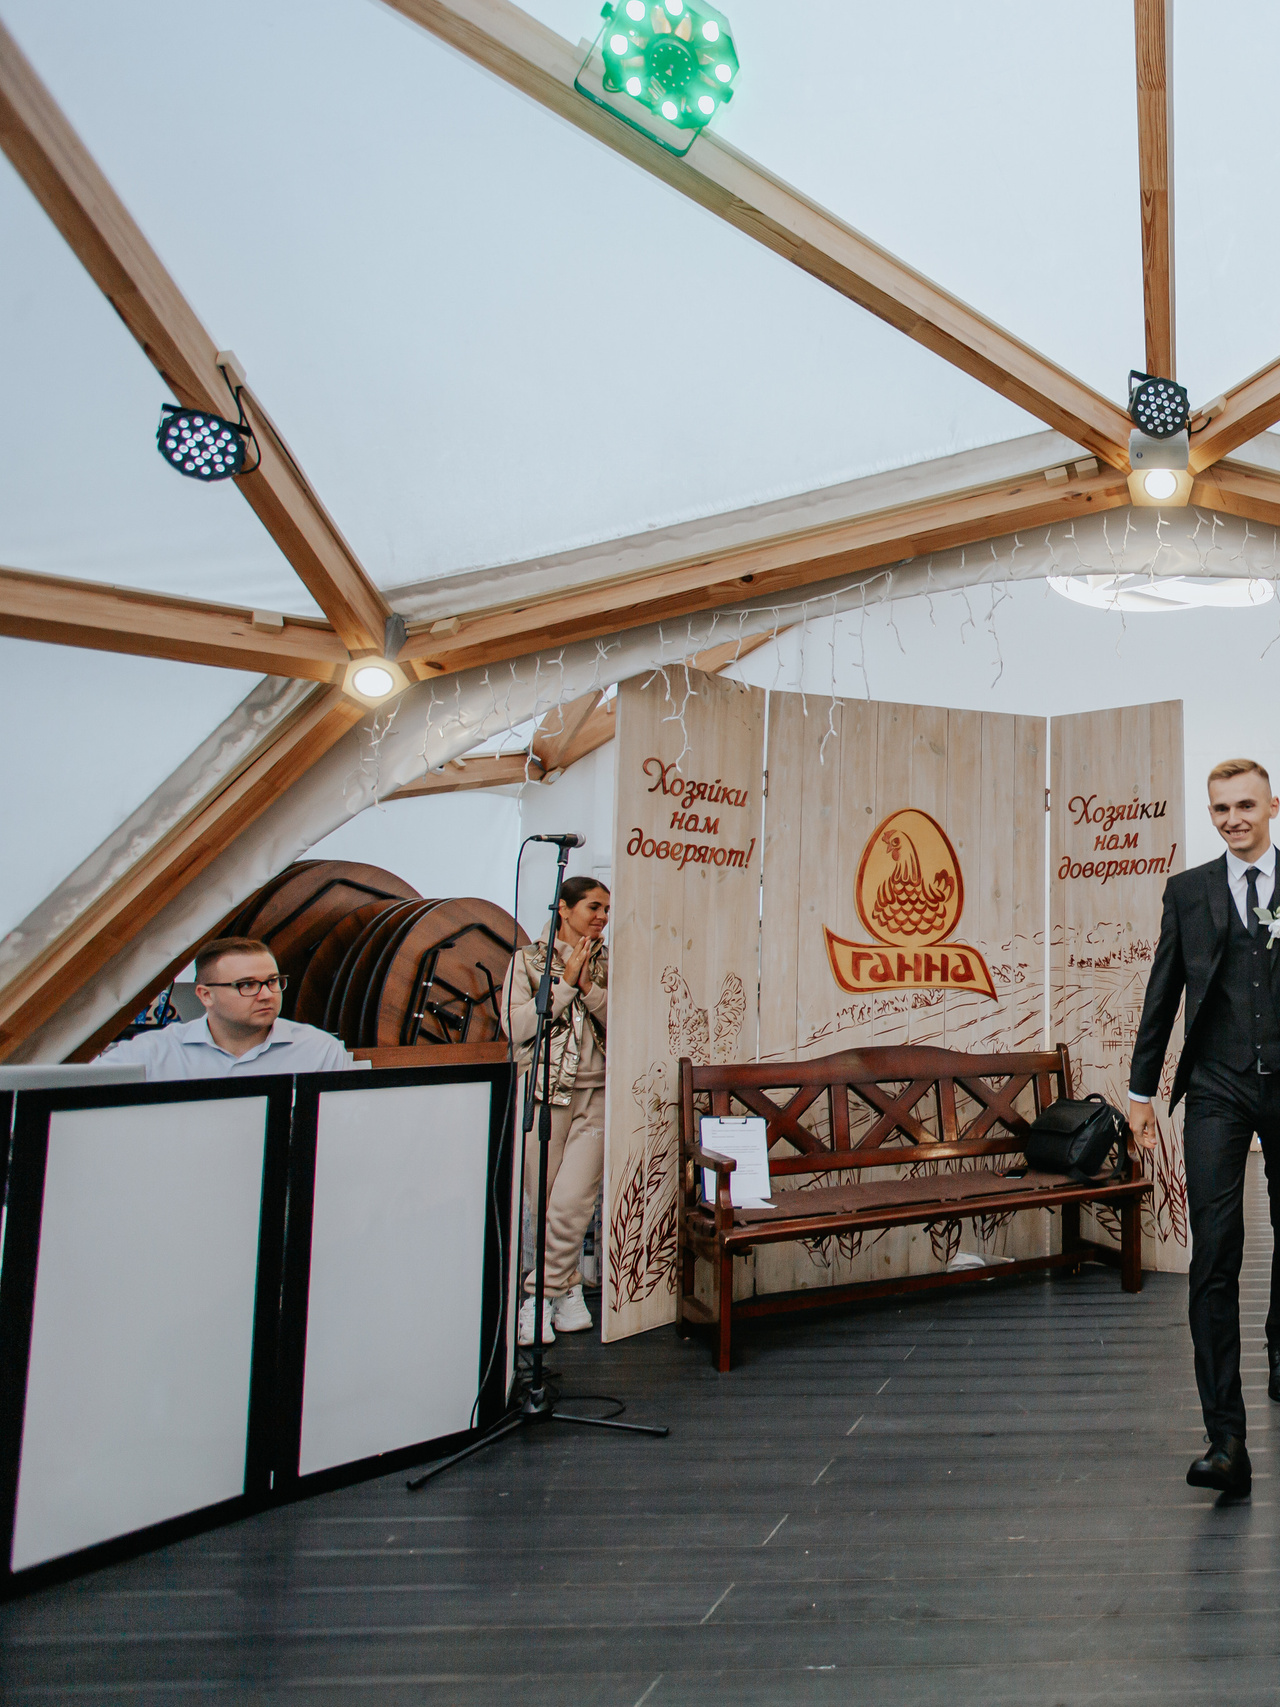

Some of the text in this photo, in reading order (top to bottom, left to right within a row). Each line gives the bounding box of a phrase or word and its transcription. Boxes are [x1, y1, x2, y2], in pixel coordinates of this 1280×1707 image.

[642, 757, 748, 809] Хозяйки
[669, 811, 720, 835] нам
[1068, 794, 1167, 832] Хозяйки
[626, 827, 756, 871] доверяют!
[1093, 832, 1139, 851] нам
[1058, 843, 1177, 885] доверяют!
